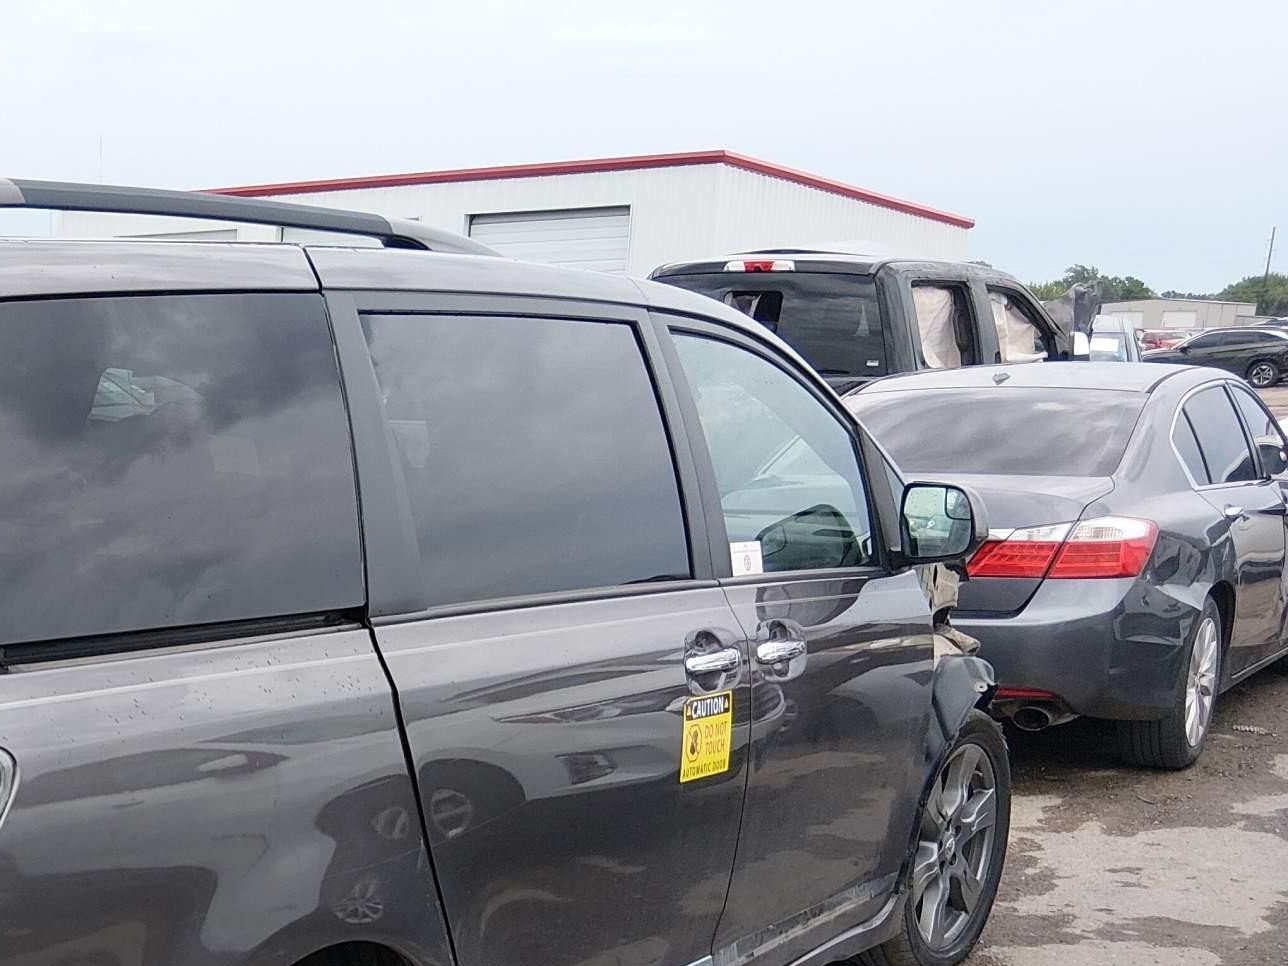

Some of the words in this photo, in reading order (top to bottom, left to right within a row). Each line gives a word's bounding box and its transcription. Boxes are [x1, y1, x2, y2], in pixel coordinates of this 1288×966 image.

[692, 696, 724, 719] CAUTION
[704, 724, 713, 738] DO
[715, 721, 728, 736] NOT
[705, 739, 725, 756] TOUCH
[683, 762, 711, 778] AUTOMATIC
